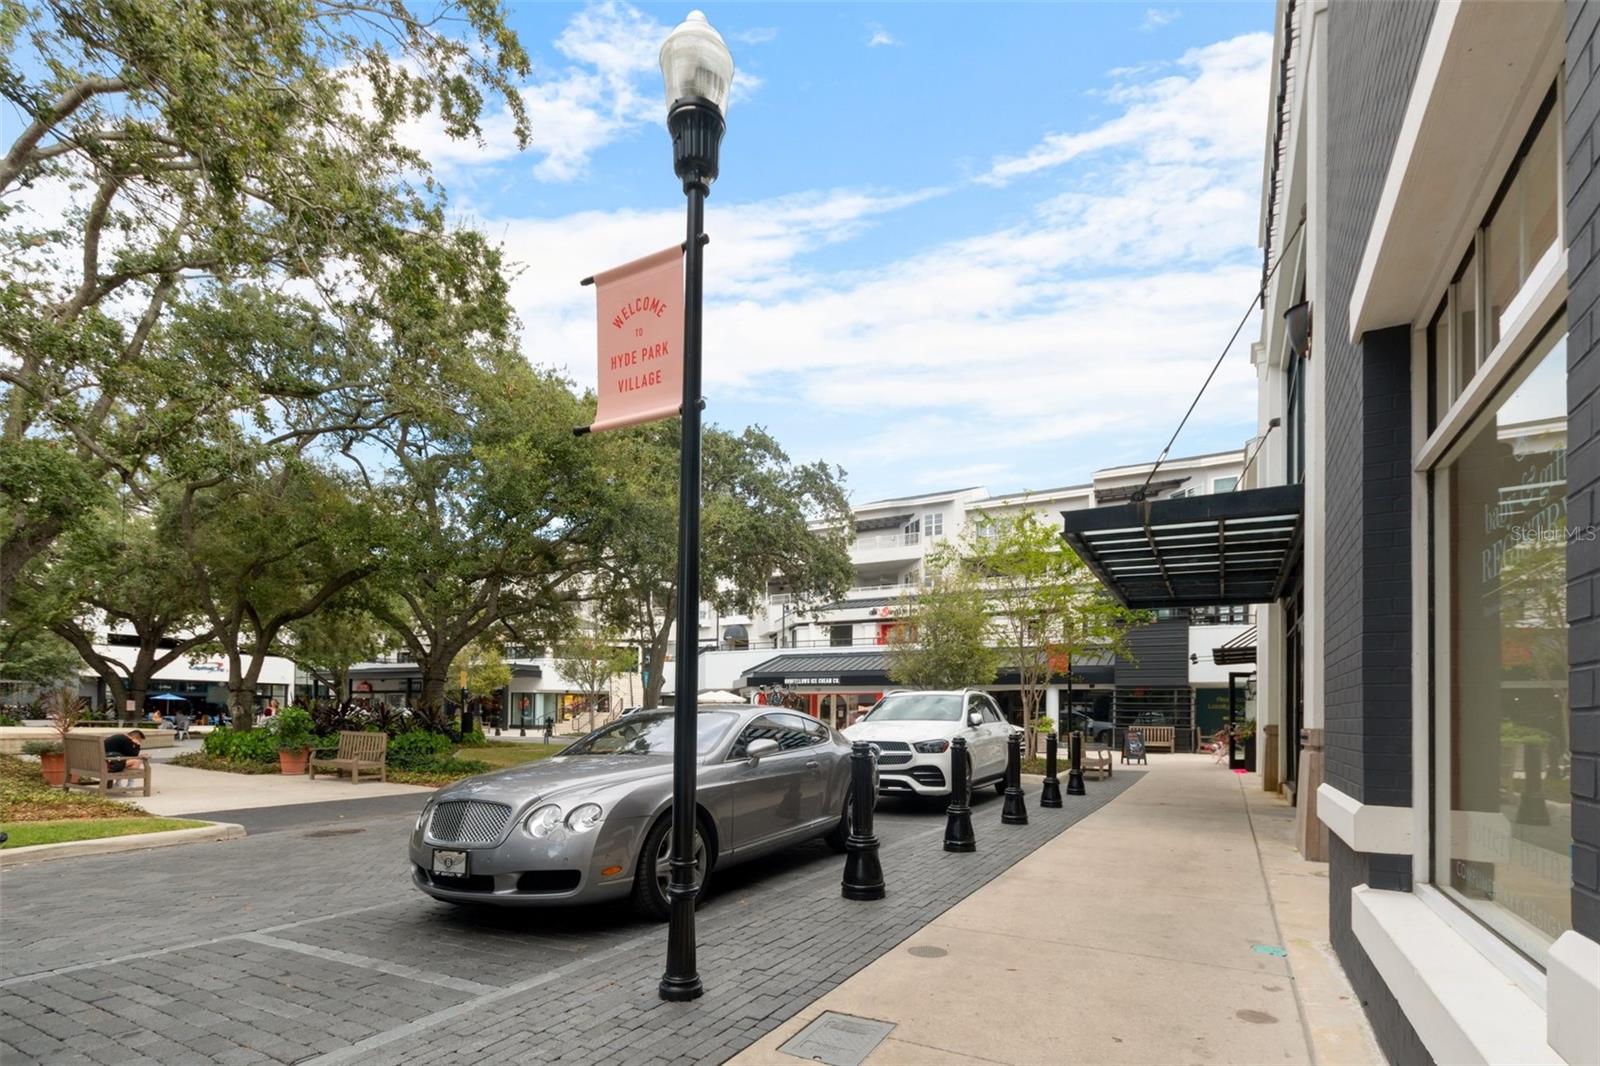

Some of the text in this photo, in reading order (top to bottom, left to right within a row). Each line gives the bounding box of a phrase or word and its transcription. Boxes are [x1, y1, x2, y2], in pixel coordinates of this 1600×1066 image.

[612, 296, 668, 329] WELCOME
[635, 327, 643, 337] TO
[610, 341, 669, 370] HYDE PARK
[617, 369, 662, 393] VILLAGE
